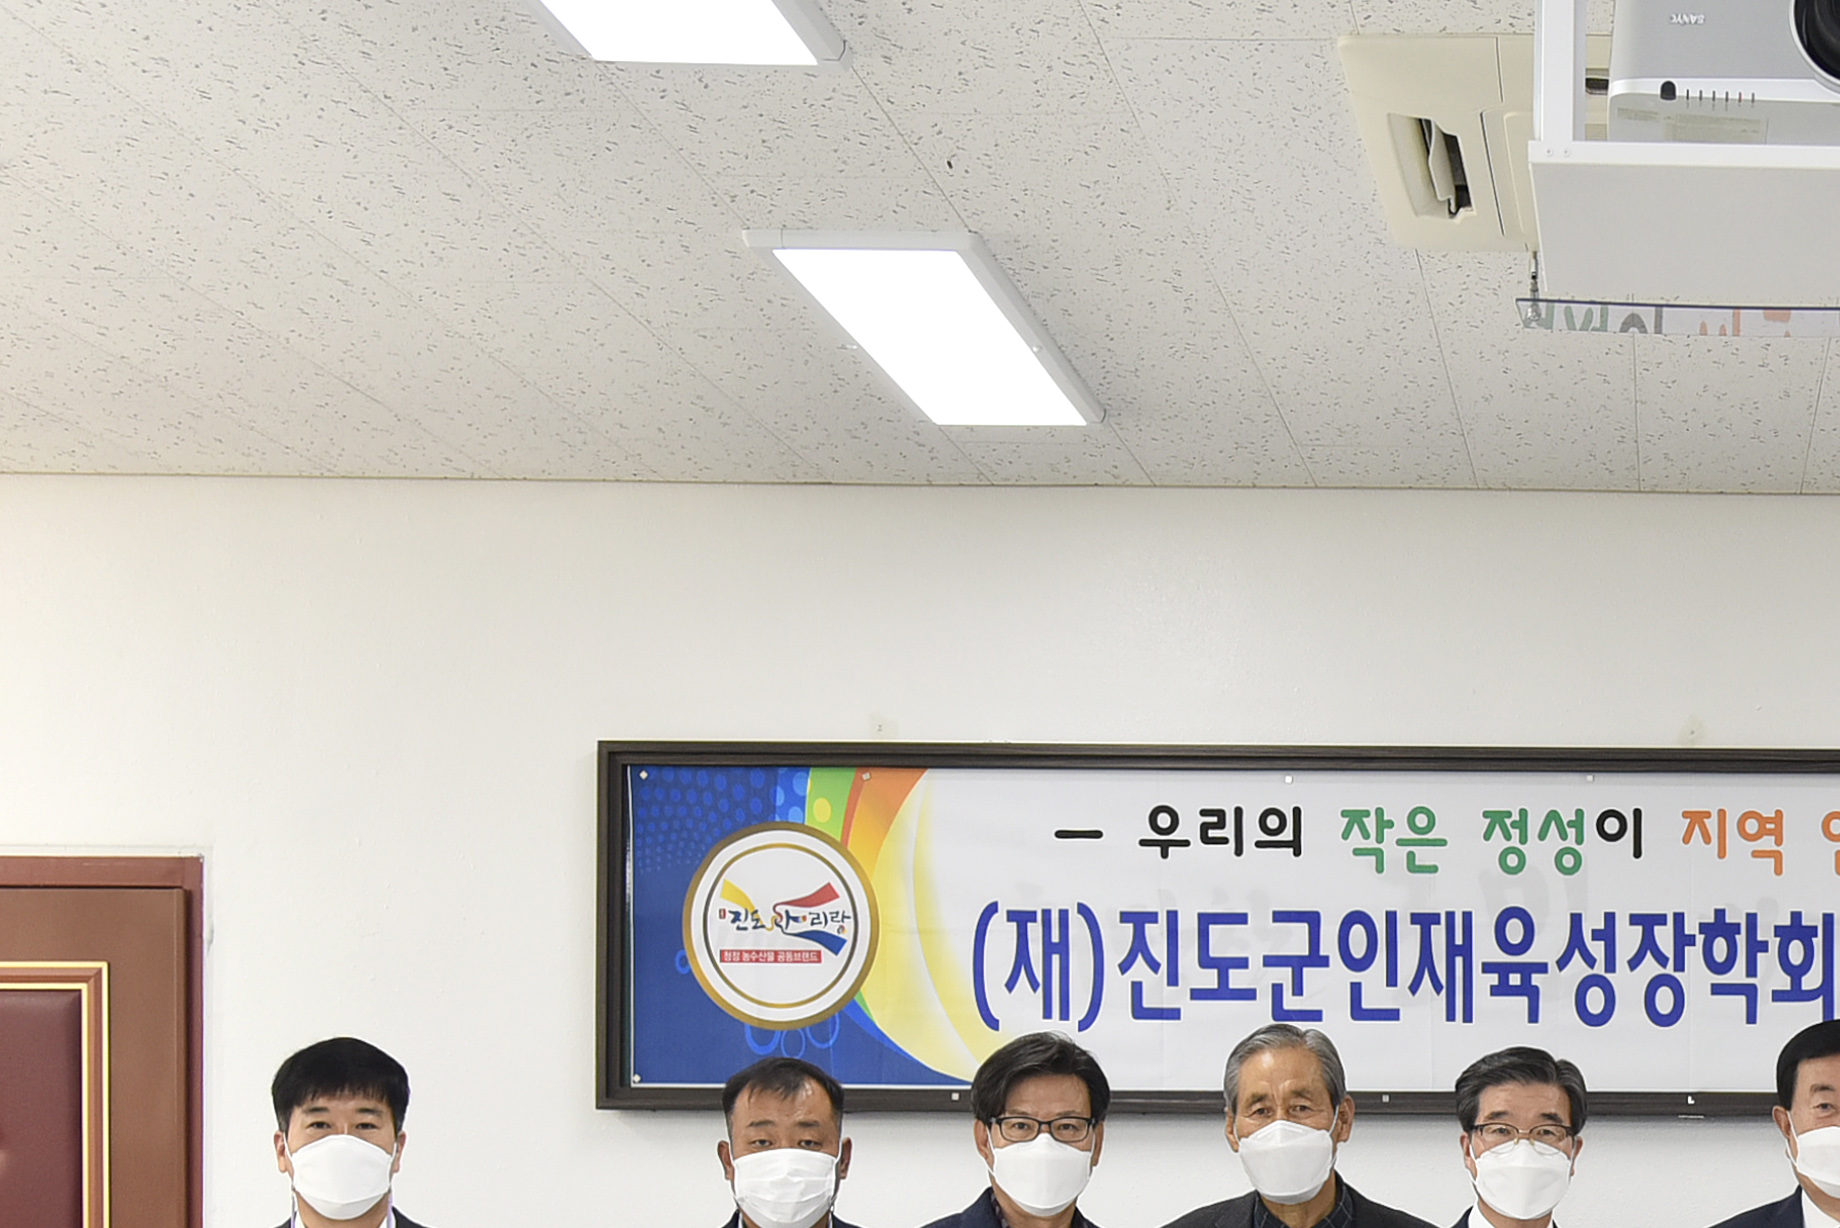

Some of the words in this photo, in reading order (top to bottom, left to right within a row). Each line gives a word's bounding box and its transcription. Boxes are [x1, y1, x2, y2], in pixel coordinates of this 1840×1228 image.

[1138, 805, 1302, 859] 우리의
[1341, 806, 1448, 874] 작은
[1482, 808, 1642, 875] 정성이
[1682, 809, 1783, 876] 지역
[742, 951, 775, 961] 농수산물
[967, 901, 1840, 1034] (재)진도군인재육성장학회
